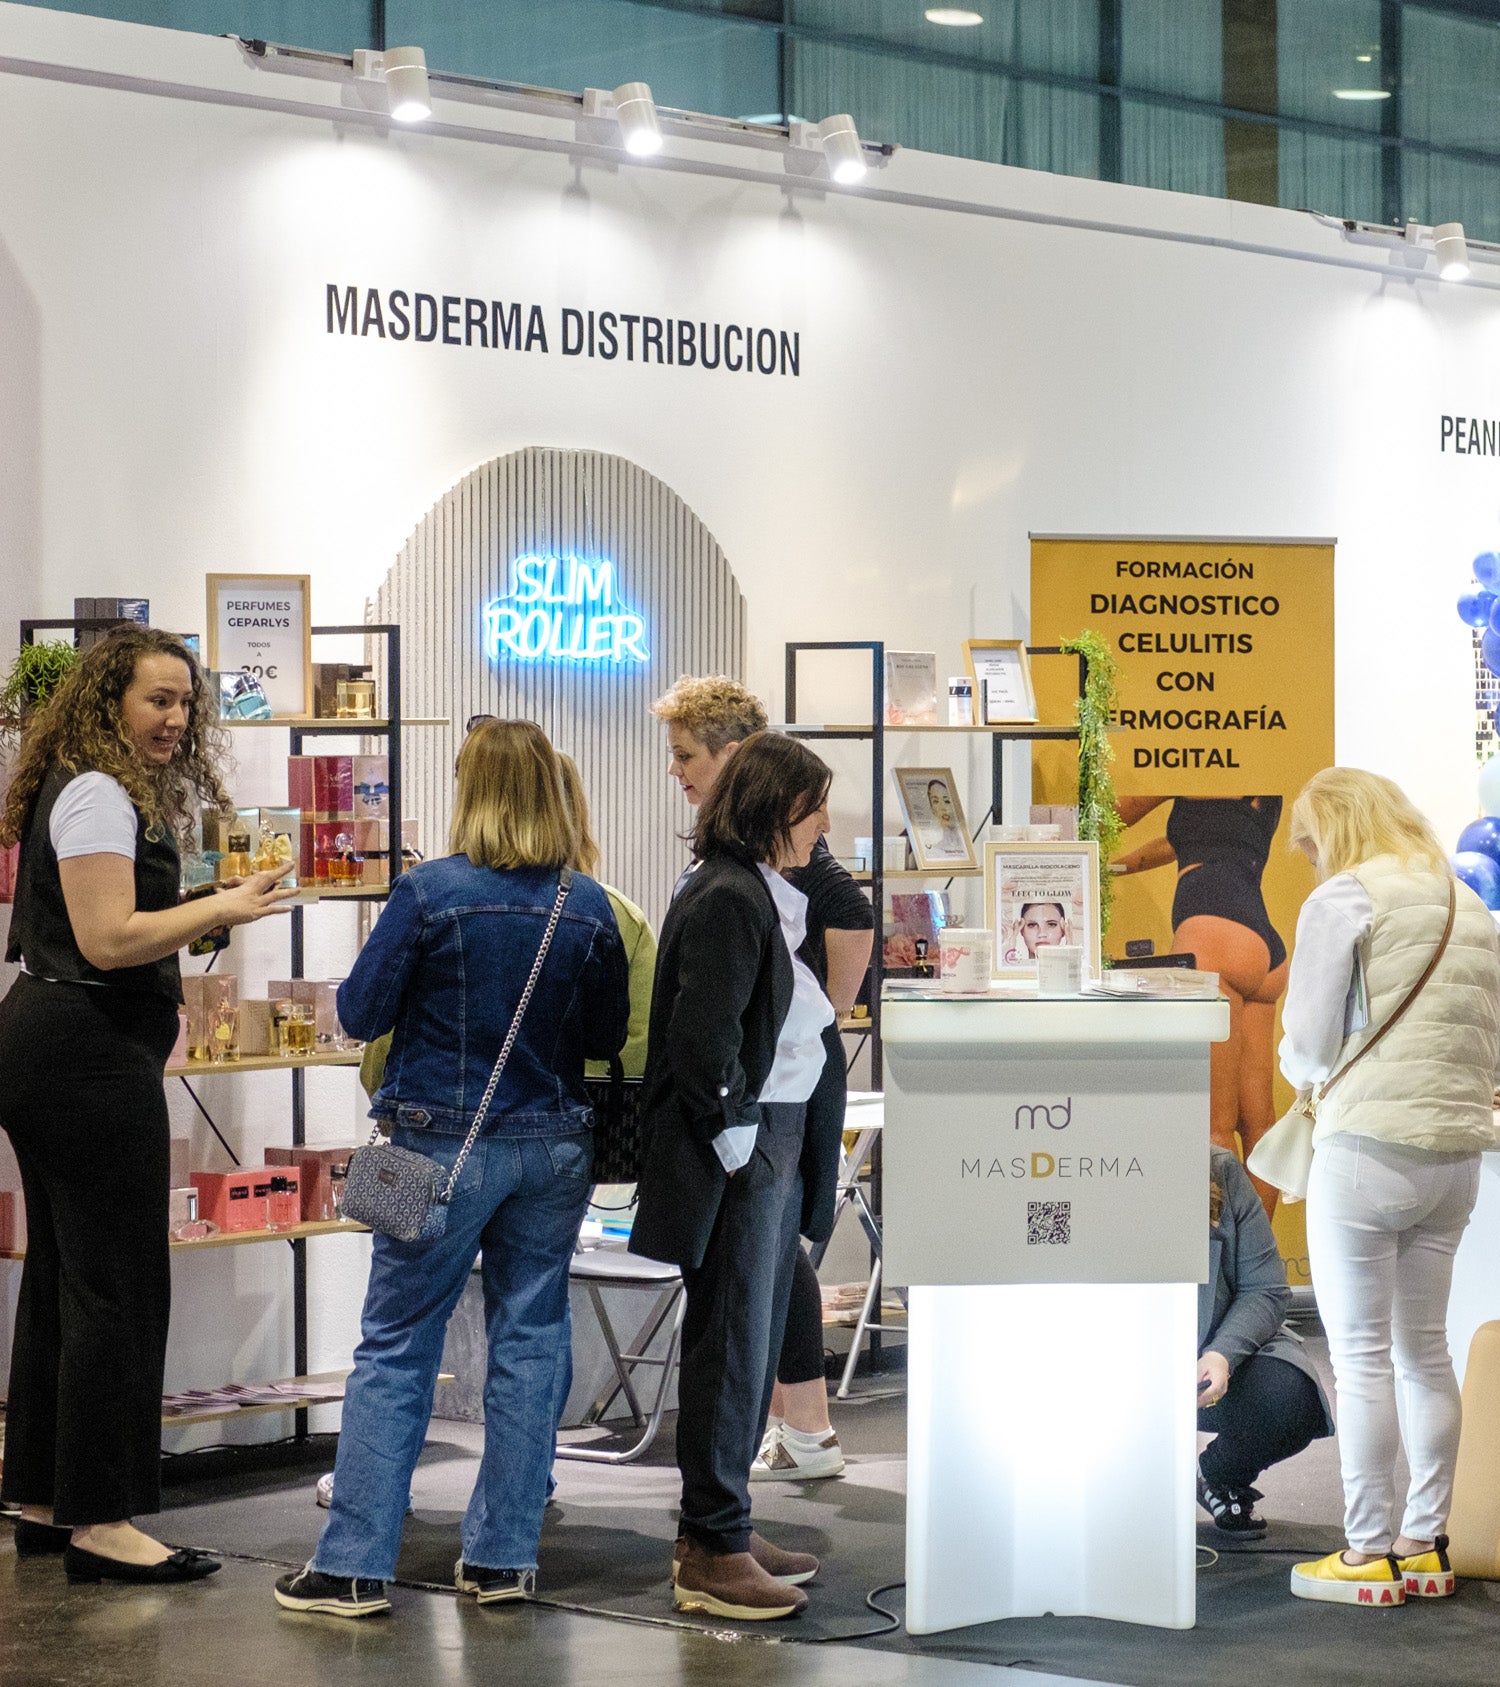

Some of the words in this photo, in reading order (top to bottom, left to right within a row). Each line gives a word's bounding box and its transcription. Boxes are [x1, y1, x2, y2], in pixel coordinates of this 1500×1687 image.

[326, 283, 549, 353] MASDERMA
[562, 307, 801, 377] DISTRIBUCION
[1116, 558, 1254, 580] FORMACIÓN
[514, 556, 614, 606] SLIM
[227, 601, 291, 611] PERFUMES
[1090, 593, 1280, 616] DIAGNOSTICO
[228, 618, 290, 628] GEPARLYS
[487, 606, 648, 660] ROLLER
[1118, 632, 1253, 654] CELULITIS
[1156, 671, 1215, 692] CON
[1133, 748, 1240, 768] DIGITAL
[961, 1152, 1144, 1179] MASDERMA
